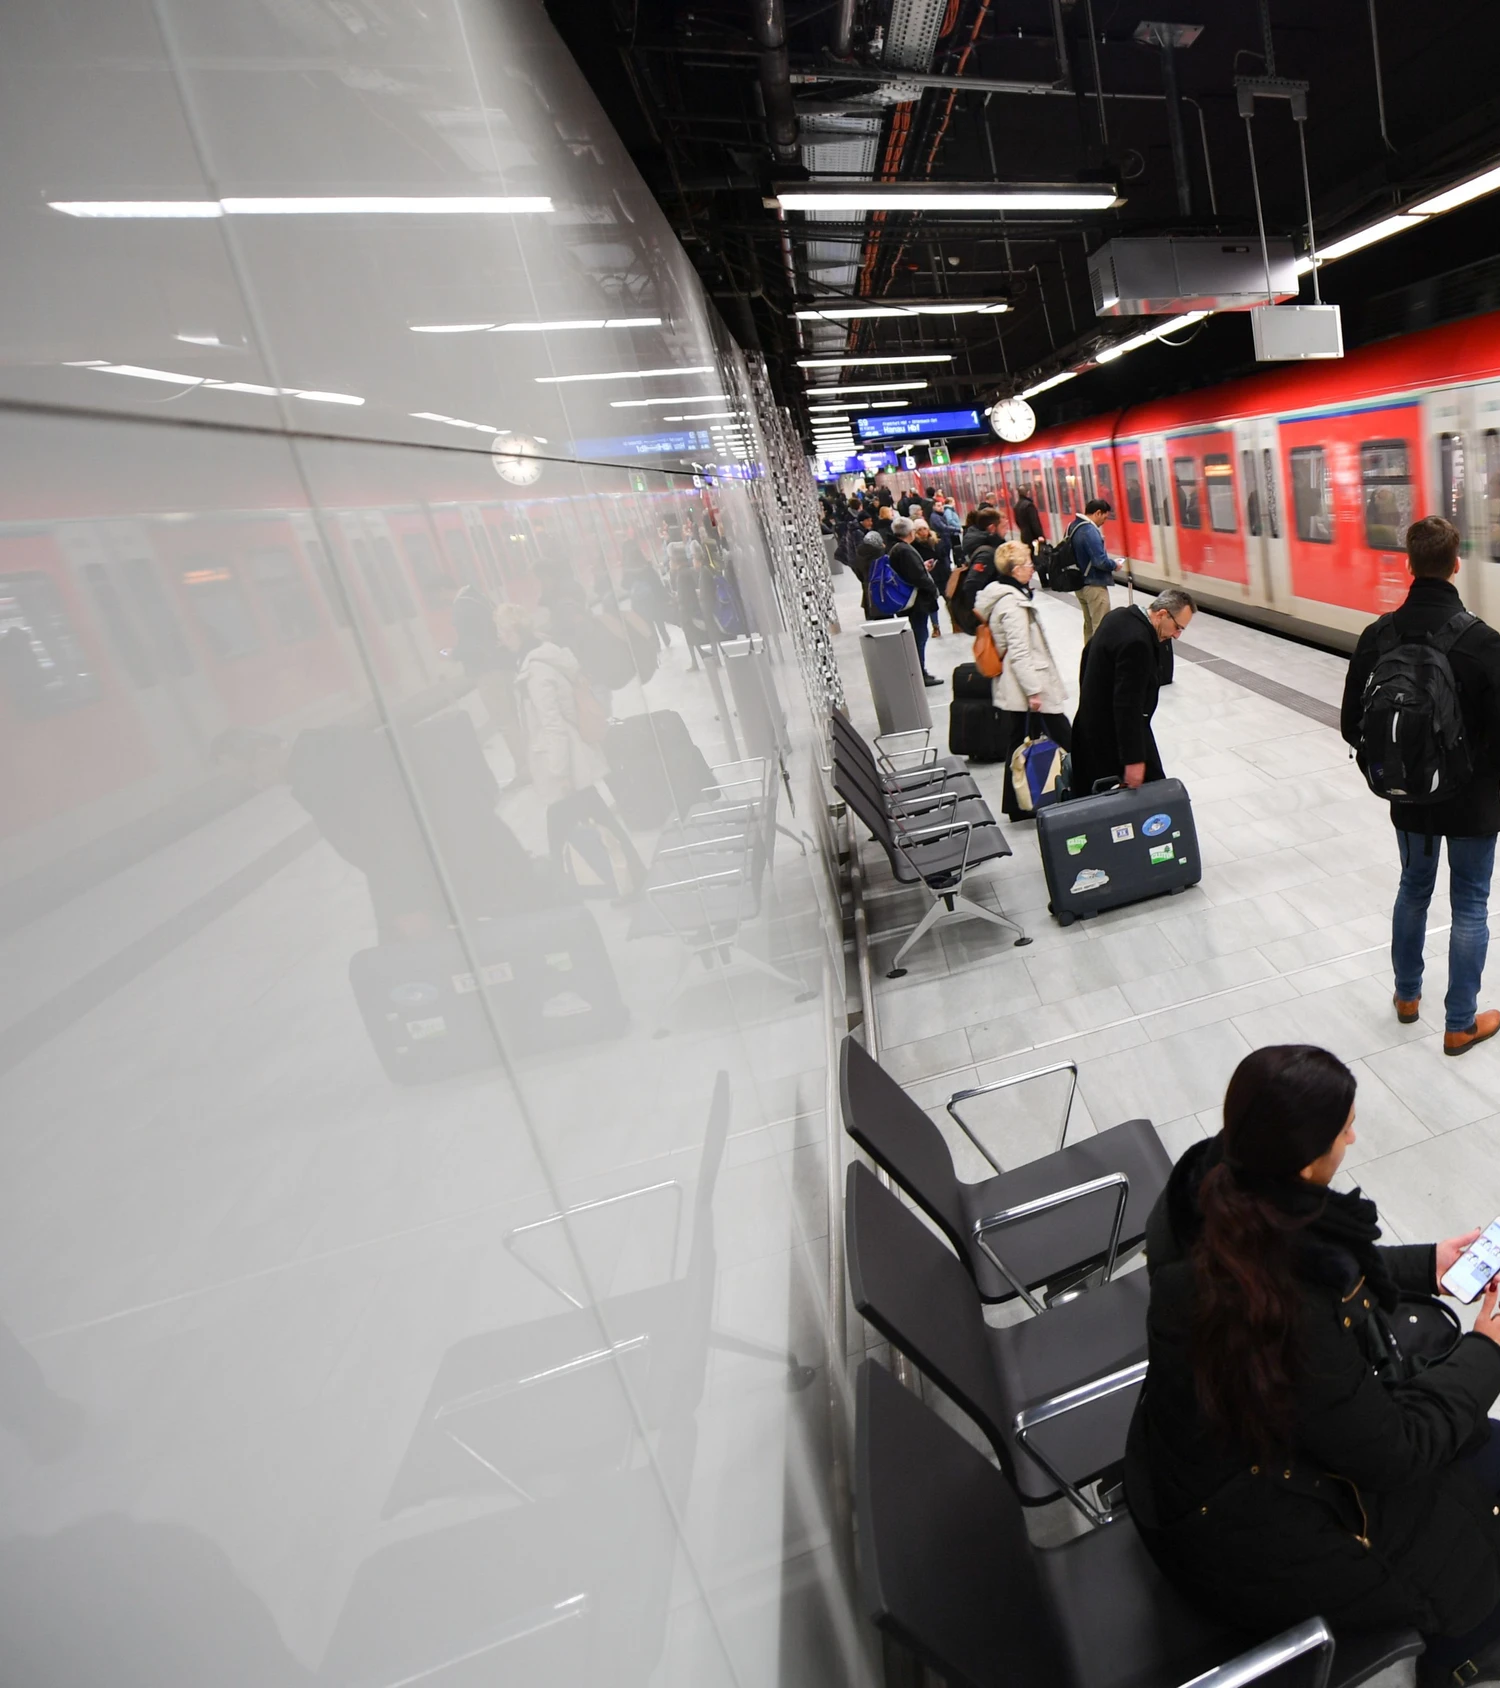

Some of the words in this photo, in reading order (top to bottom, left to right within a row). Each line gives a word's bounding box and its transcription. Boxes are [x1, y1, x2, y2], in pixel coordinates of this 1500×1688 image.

[857, 418, 869, 427] S9
[970, 410, 979, 425] 1
[883, 425, 906, 435] Hanau
[907, 423, 920, 432] Hbf
[906, 456, 917, 470] B
